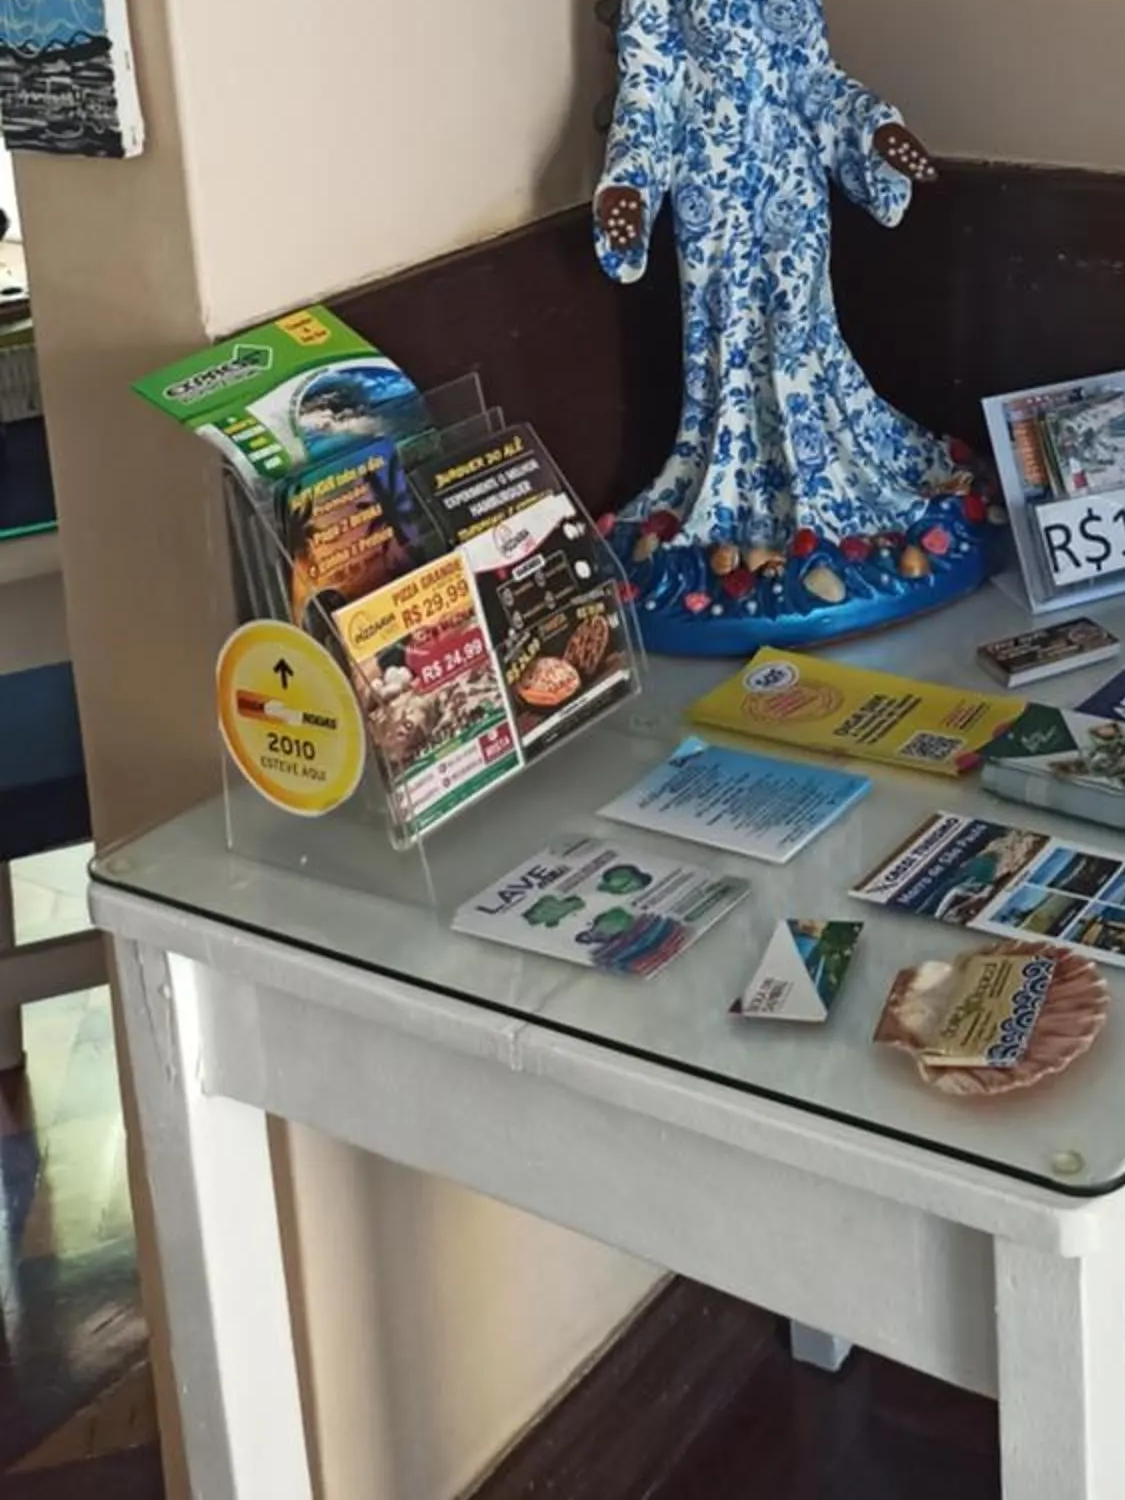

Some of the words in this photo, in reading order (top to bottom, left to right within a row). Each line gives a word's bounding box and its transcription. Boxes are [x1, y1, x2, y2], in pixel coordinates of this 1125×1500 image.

[392, 583, 419, 607] PIZZA
[420, 558, 462, 589] GRANDE
[401, 604, 423, 629] R$
[423, 578, 470, 617] 29,99
[421, 659, 443, 684] R$
[266, 732, 316, 761] 2010
[260, 755, 298, 776] ESTEVE
[302, 767, 327, 783] AQUI
[475, 864, 551, 916] LAVE
